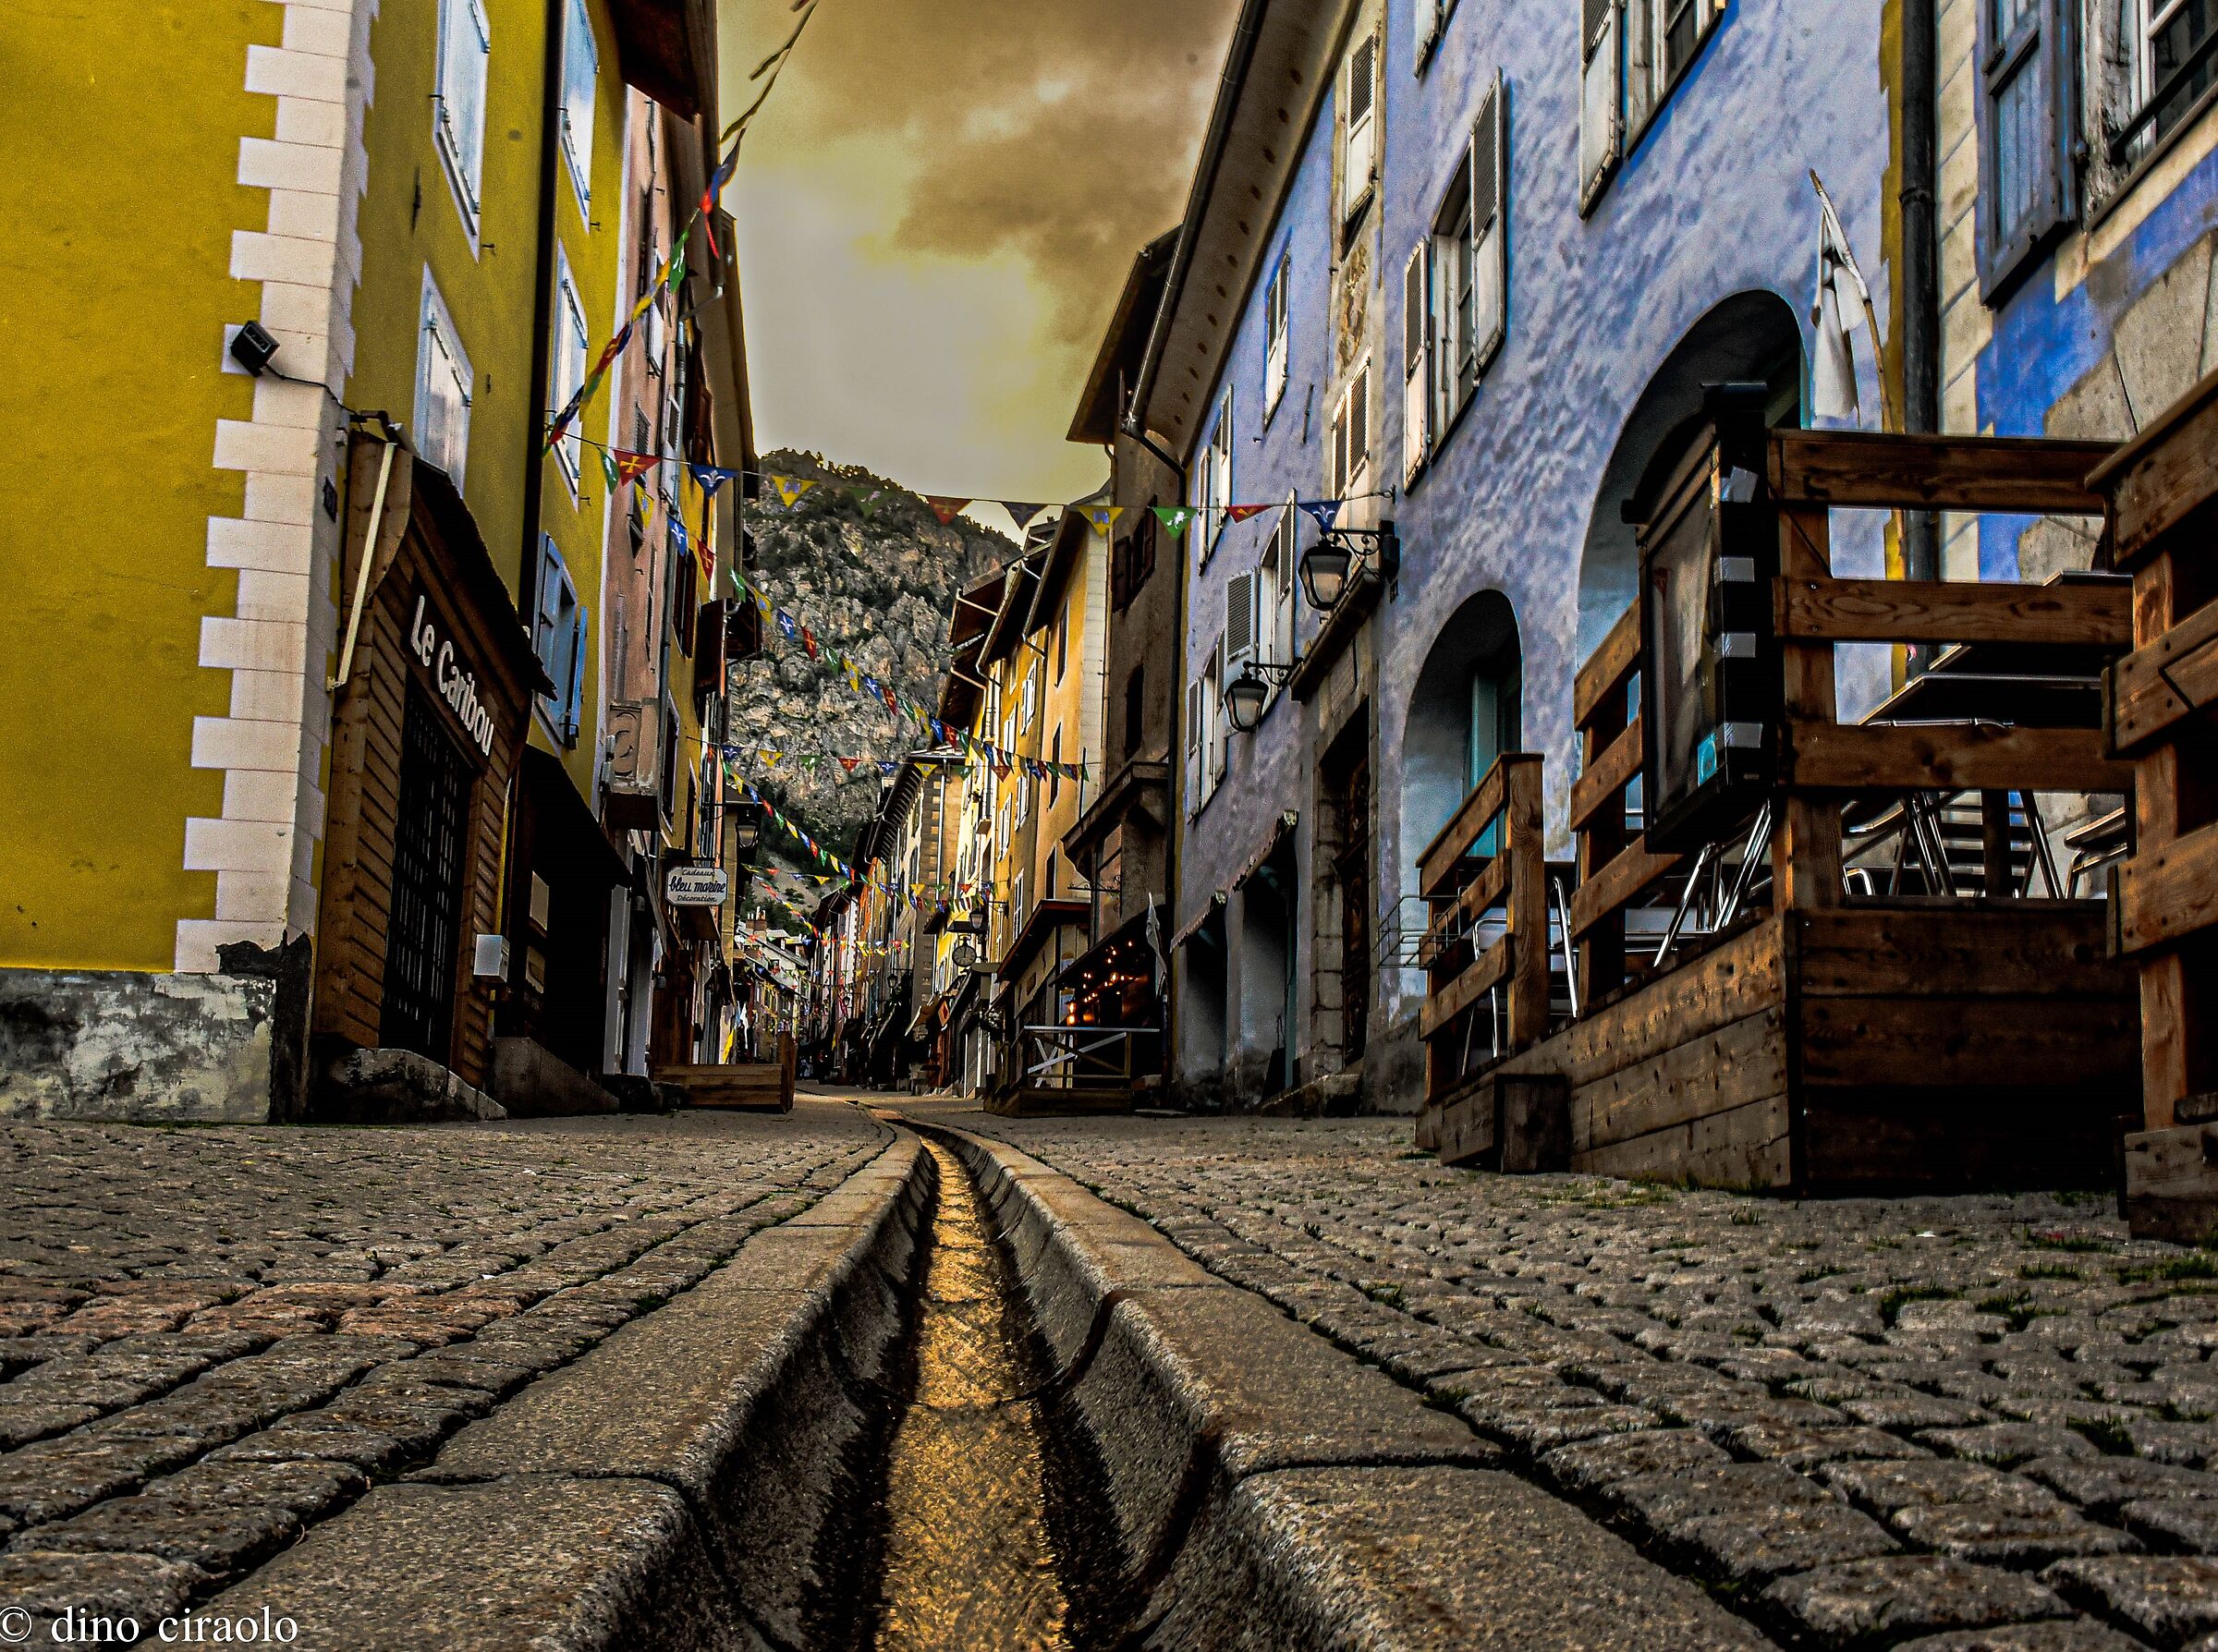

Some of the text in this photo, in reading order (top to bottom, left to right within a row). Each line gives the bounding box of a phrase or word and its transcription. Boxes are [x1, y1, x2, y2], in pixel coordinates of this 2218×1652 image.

[410, 595, 494, 757] Le Caribou
[682, 869, 715, 877] Cadeaux
[669, 875, 726, 893] bleu marine
[676, 894, 717, 903] Décoration
